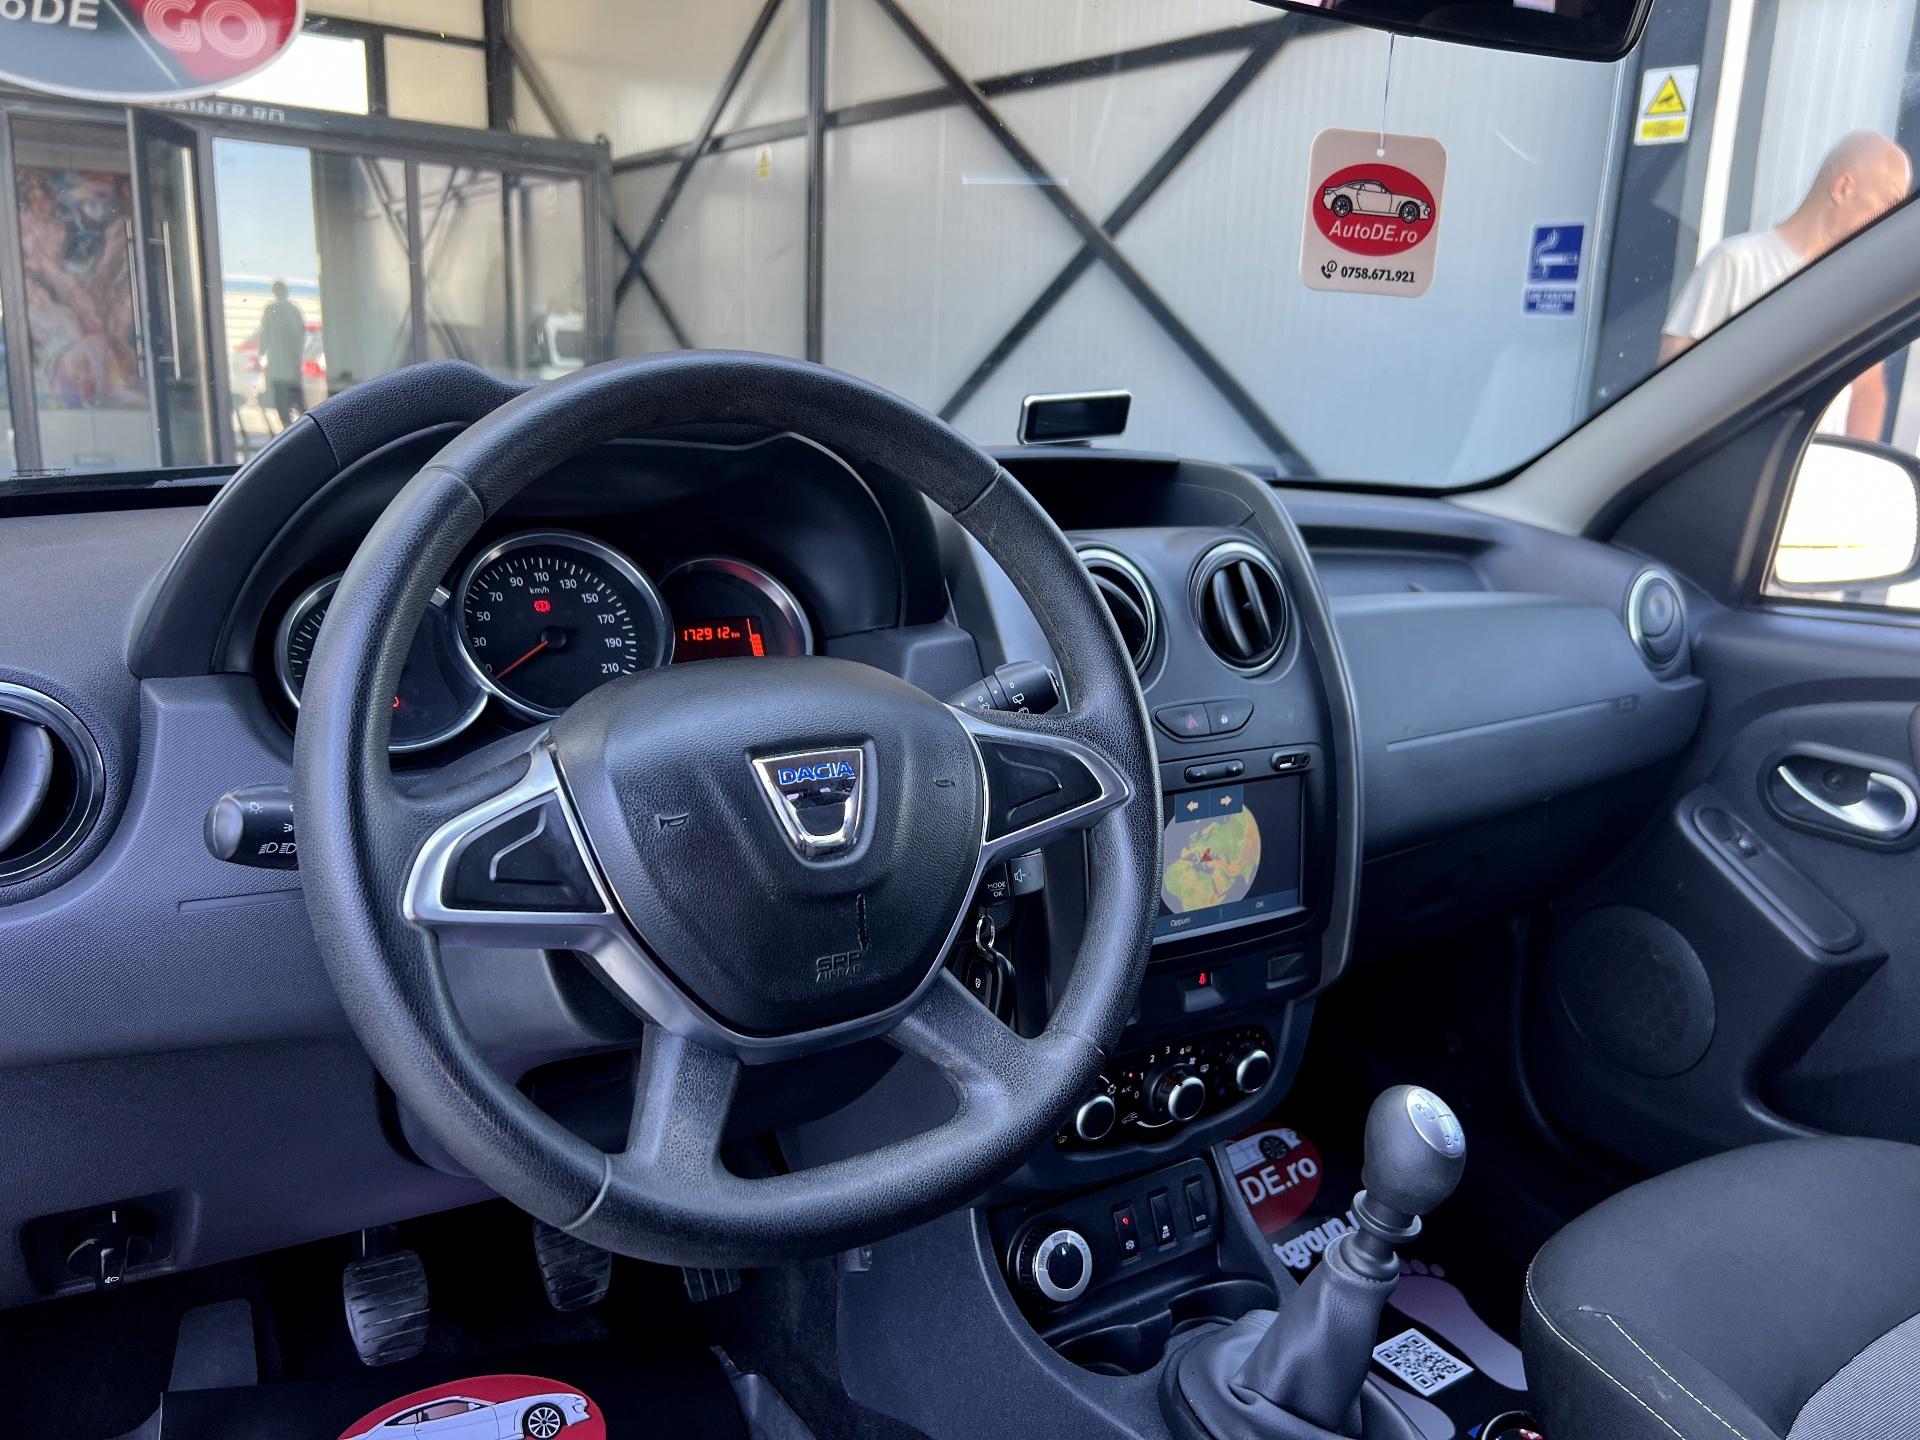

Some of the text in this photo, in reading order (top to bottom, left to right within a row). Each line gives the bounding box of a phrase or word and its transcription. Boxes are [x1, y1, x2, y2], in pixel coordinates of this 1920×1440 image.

[143, 0, 267, 59] GO
[1328, 220, 1417, 243] AutoDE.ro
[1341, 266, 1415, 283] 0758.671.921
[509, 577, 523, 587] 90
[534, 572, 549, 582] 110
[560, 579, 577, 589] 130
[529, 586, 550, 594] km/h
[489, 592, 503, 601] 70
[582, 594, 599, 603] 150
[477, 612, 491, 622] 50
[598, 614, 615, 625] 170
[684, 627, 730, 641] 172912
[473, 637, 487, 647] 30
[605, 638, 622, 648] 190
[601, 663, 619, 673] 210
[778, 760, 855, 785] DACIA
[987, 881, 1006, 890] MODE
[993, 890, 1003, 898] OK
[1255, 901, 1265, 909] OK
[1240, 1157, 1317, 1205] DE.ro
